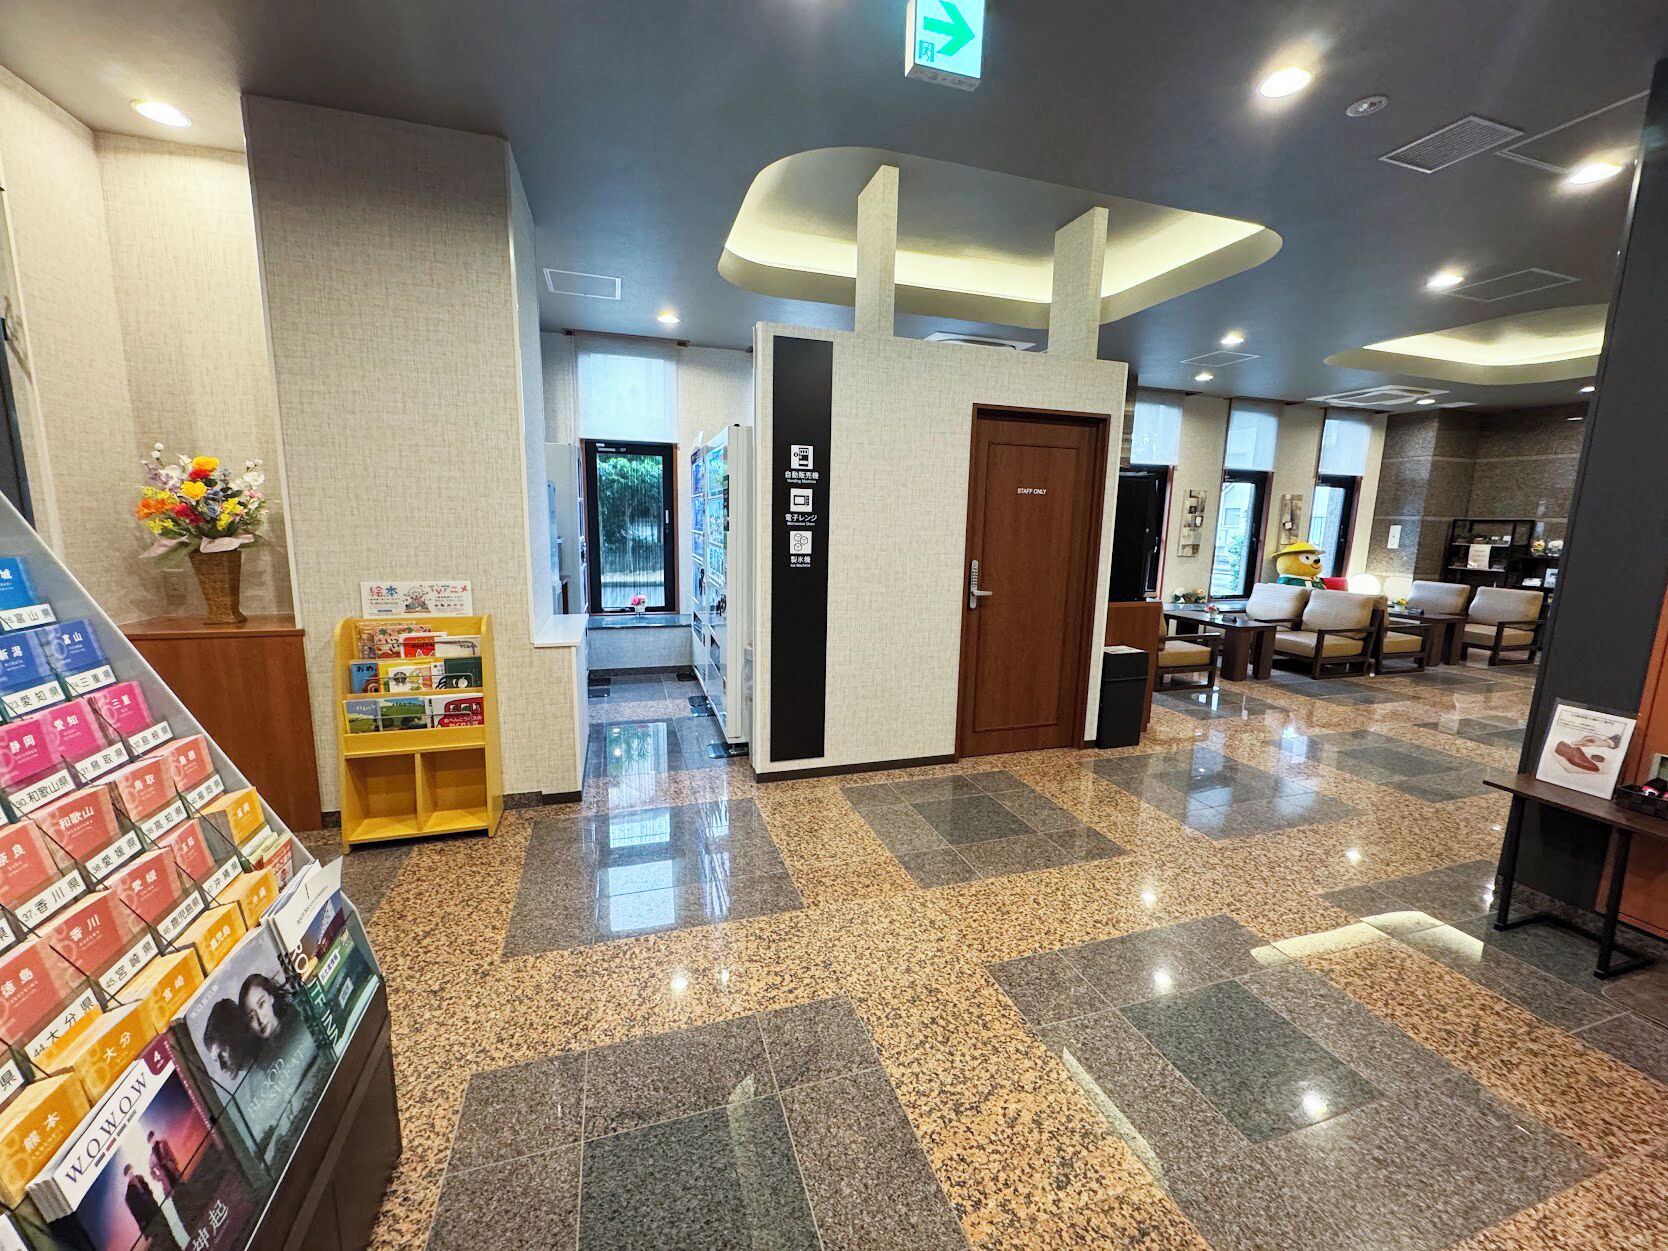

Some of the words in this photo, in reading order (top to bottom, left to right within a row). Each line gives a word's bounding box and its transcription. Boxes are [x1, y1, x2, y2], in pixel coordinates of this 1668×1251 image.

[785, 470, 819, 479] 自動販売機
[785, 514, 818, 522] 電子レンジ
[790, 556, 811, 564] 製氷機
[369, 585, 399, 598] 絵本
[62, 632, 83, 645] 富山
[80, 669, 112, 688] 三重県
[20, 686, 60, 707] 愛知県
[111, 694, 132, 709] 三重
[54, 715, 79, 732] 愛知
[9, 735, 36, 754] 静岡
[90, 748, 126, 771] 鳥取県
[27, 776, 71, 804] 和歌山県
[59, 806, 95, 830] 和歌山
[153, 805, 184, 830] 高知県
[101, 837, 137, 867] 愛媛県
[34, 876, 80, 914] 香川県
[170, 896, 201, 930] 鹿児島県
[69, 913, 100, 942] 香川
[115, 940, 153, 981] 宮崎県
[46, 996, 95, 1044] 大分県
[103, 1031, 131, 1064] 大分
[153, 1050, 161, 1062] 4
[65, 1071, 148, 1185] WOWOW
